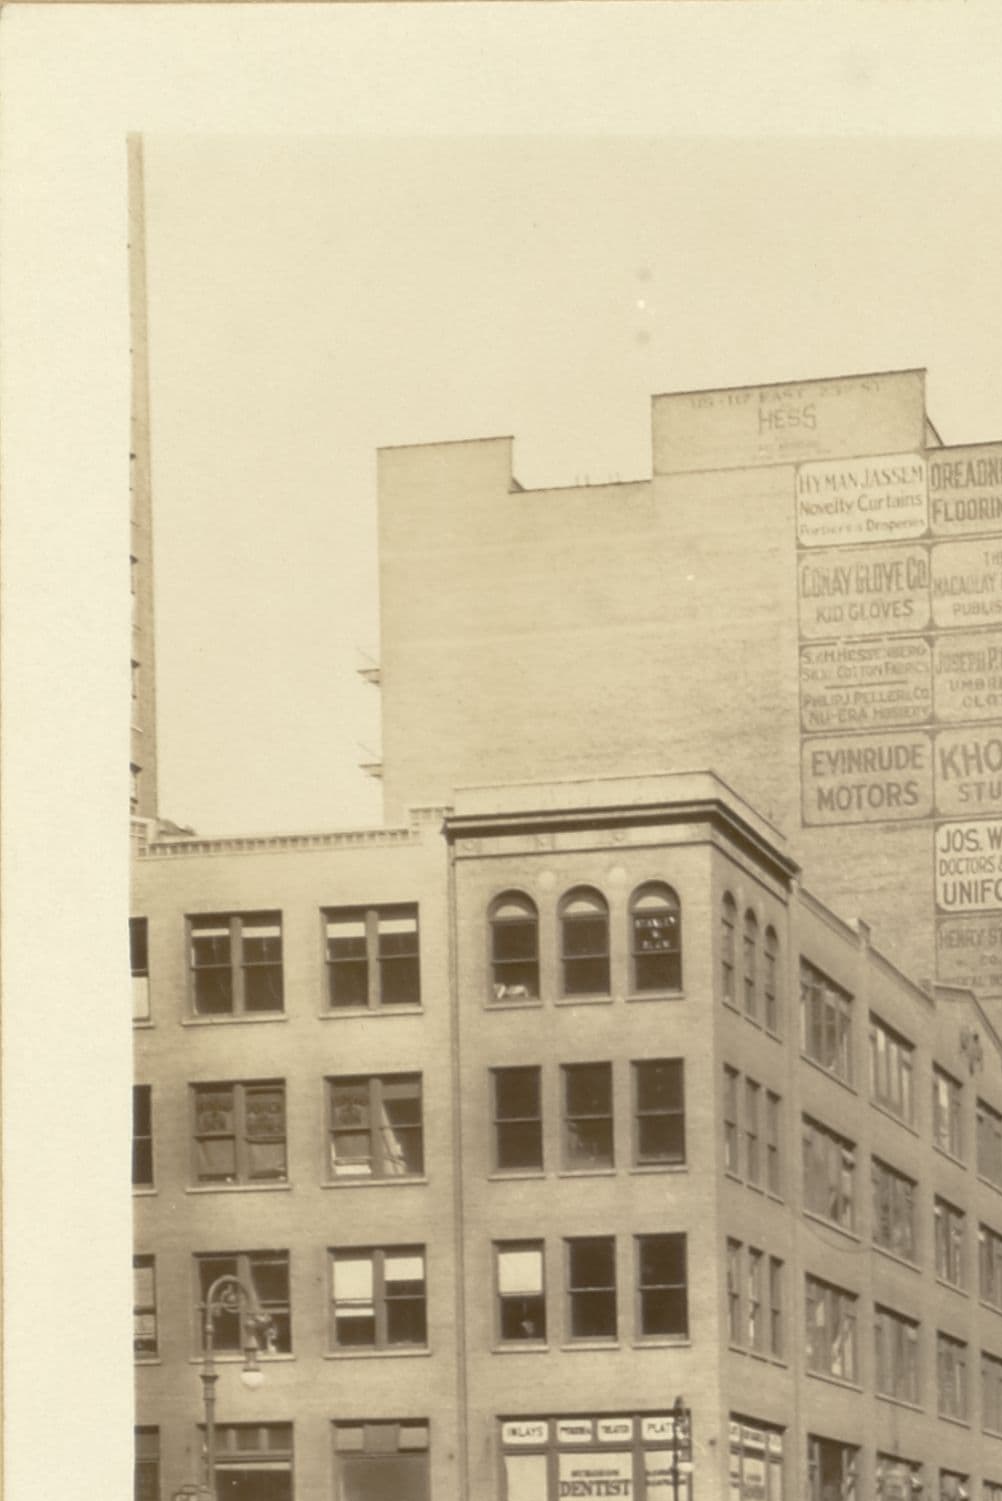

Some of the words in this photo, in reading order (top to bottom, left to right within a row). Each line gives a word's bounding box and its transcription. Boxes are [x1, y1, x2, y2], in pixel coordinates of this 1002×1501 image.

[758, 403, 817, 433] HESS
[799, 498, 854, 516] Novelty
[857, 494, 922, 513] Curtains
[816, 604, 844, 624] KID
[848, 599, 914, 622] GLOVES
[811, 743, 926, 777] EVINRUDE
[816, 779, 920, 813] MOTORS
[939, 828, 983, 854] JOS.
[939, 856, 996, 877] DOCTORS
[506, 1425, 545, 1439] INLAYS
[560, 1479, 632, 1497] DENTIST
